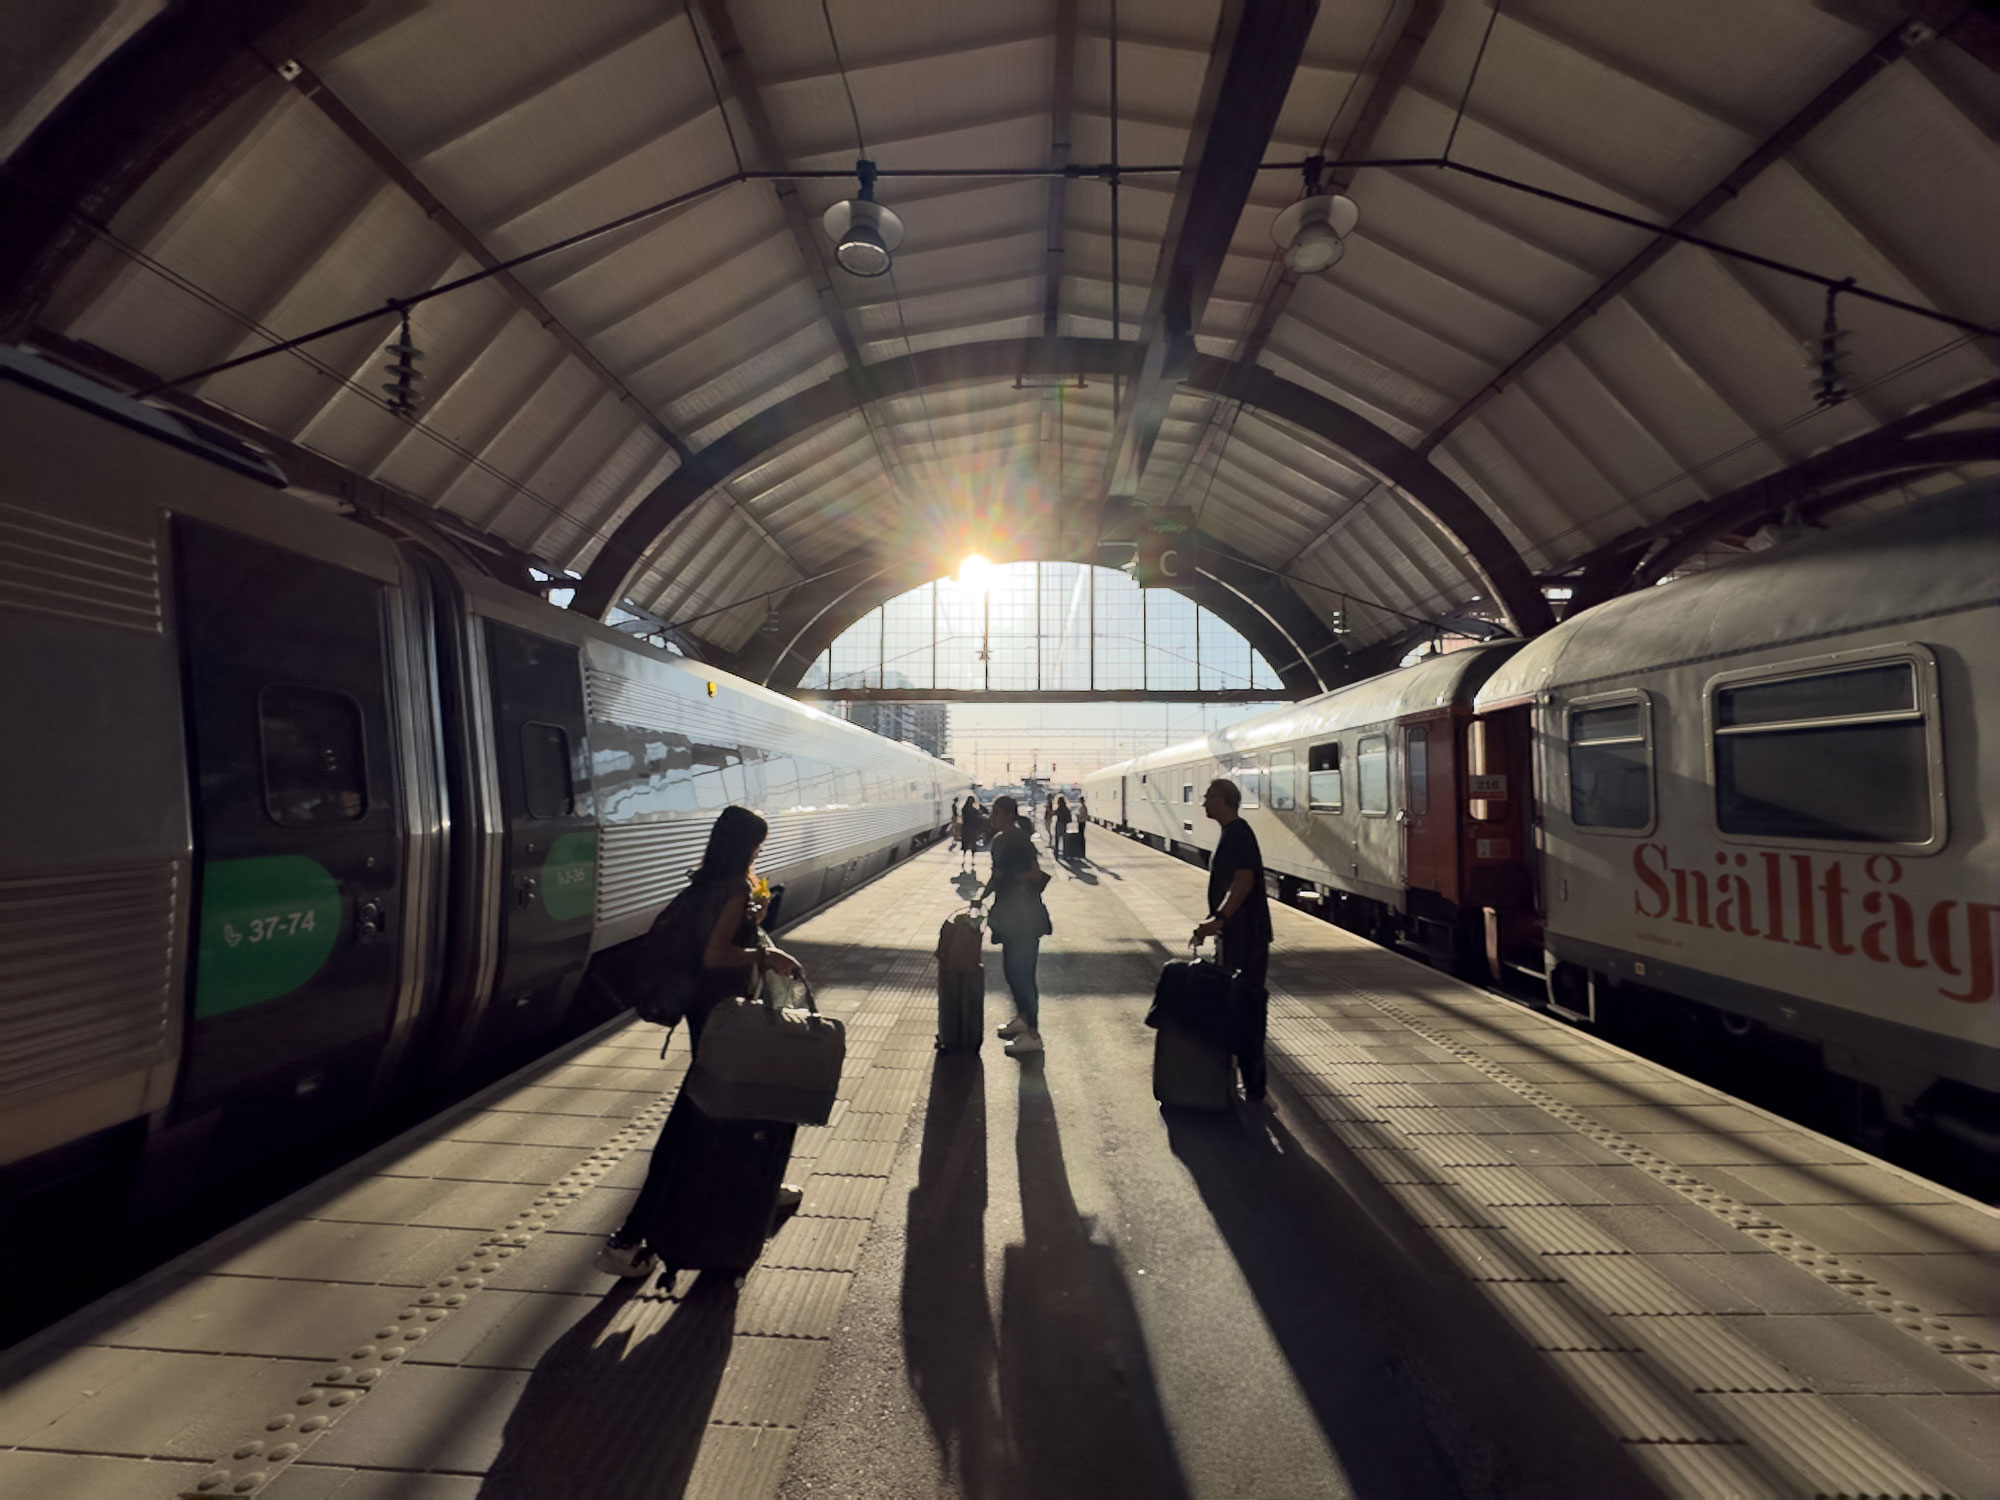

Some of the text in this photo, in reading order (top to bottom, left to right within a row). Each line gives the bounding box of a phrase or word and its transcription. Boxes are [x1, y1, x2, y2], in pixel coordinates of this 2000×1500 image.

[1160, 550, 1178, 577] C
[1476, 780, 1500, 791] 216
[248, 909, 317, 943] 37-74
